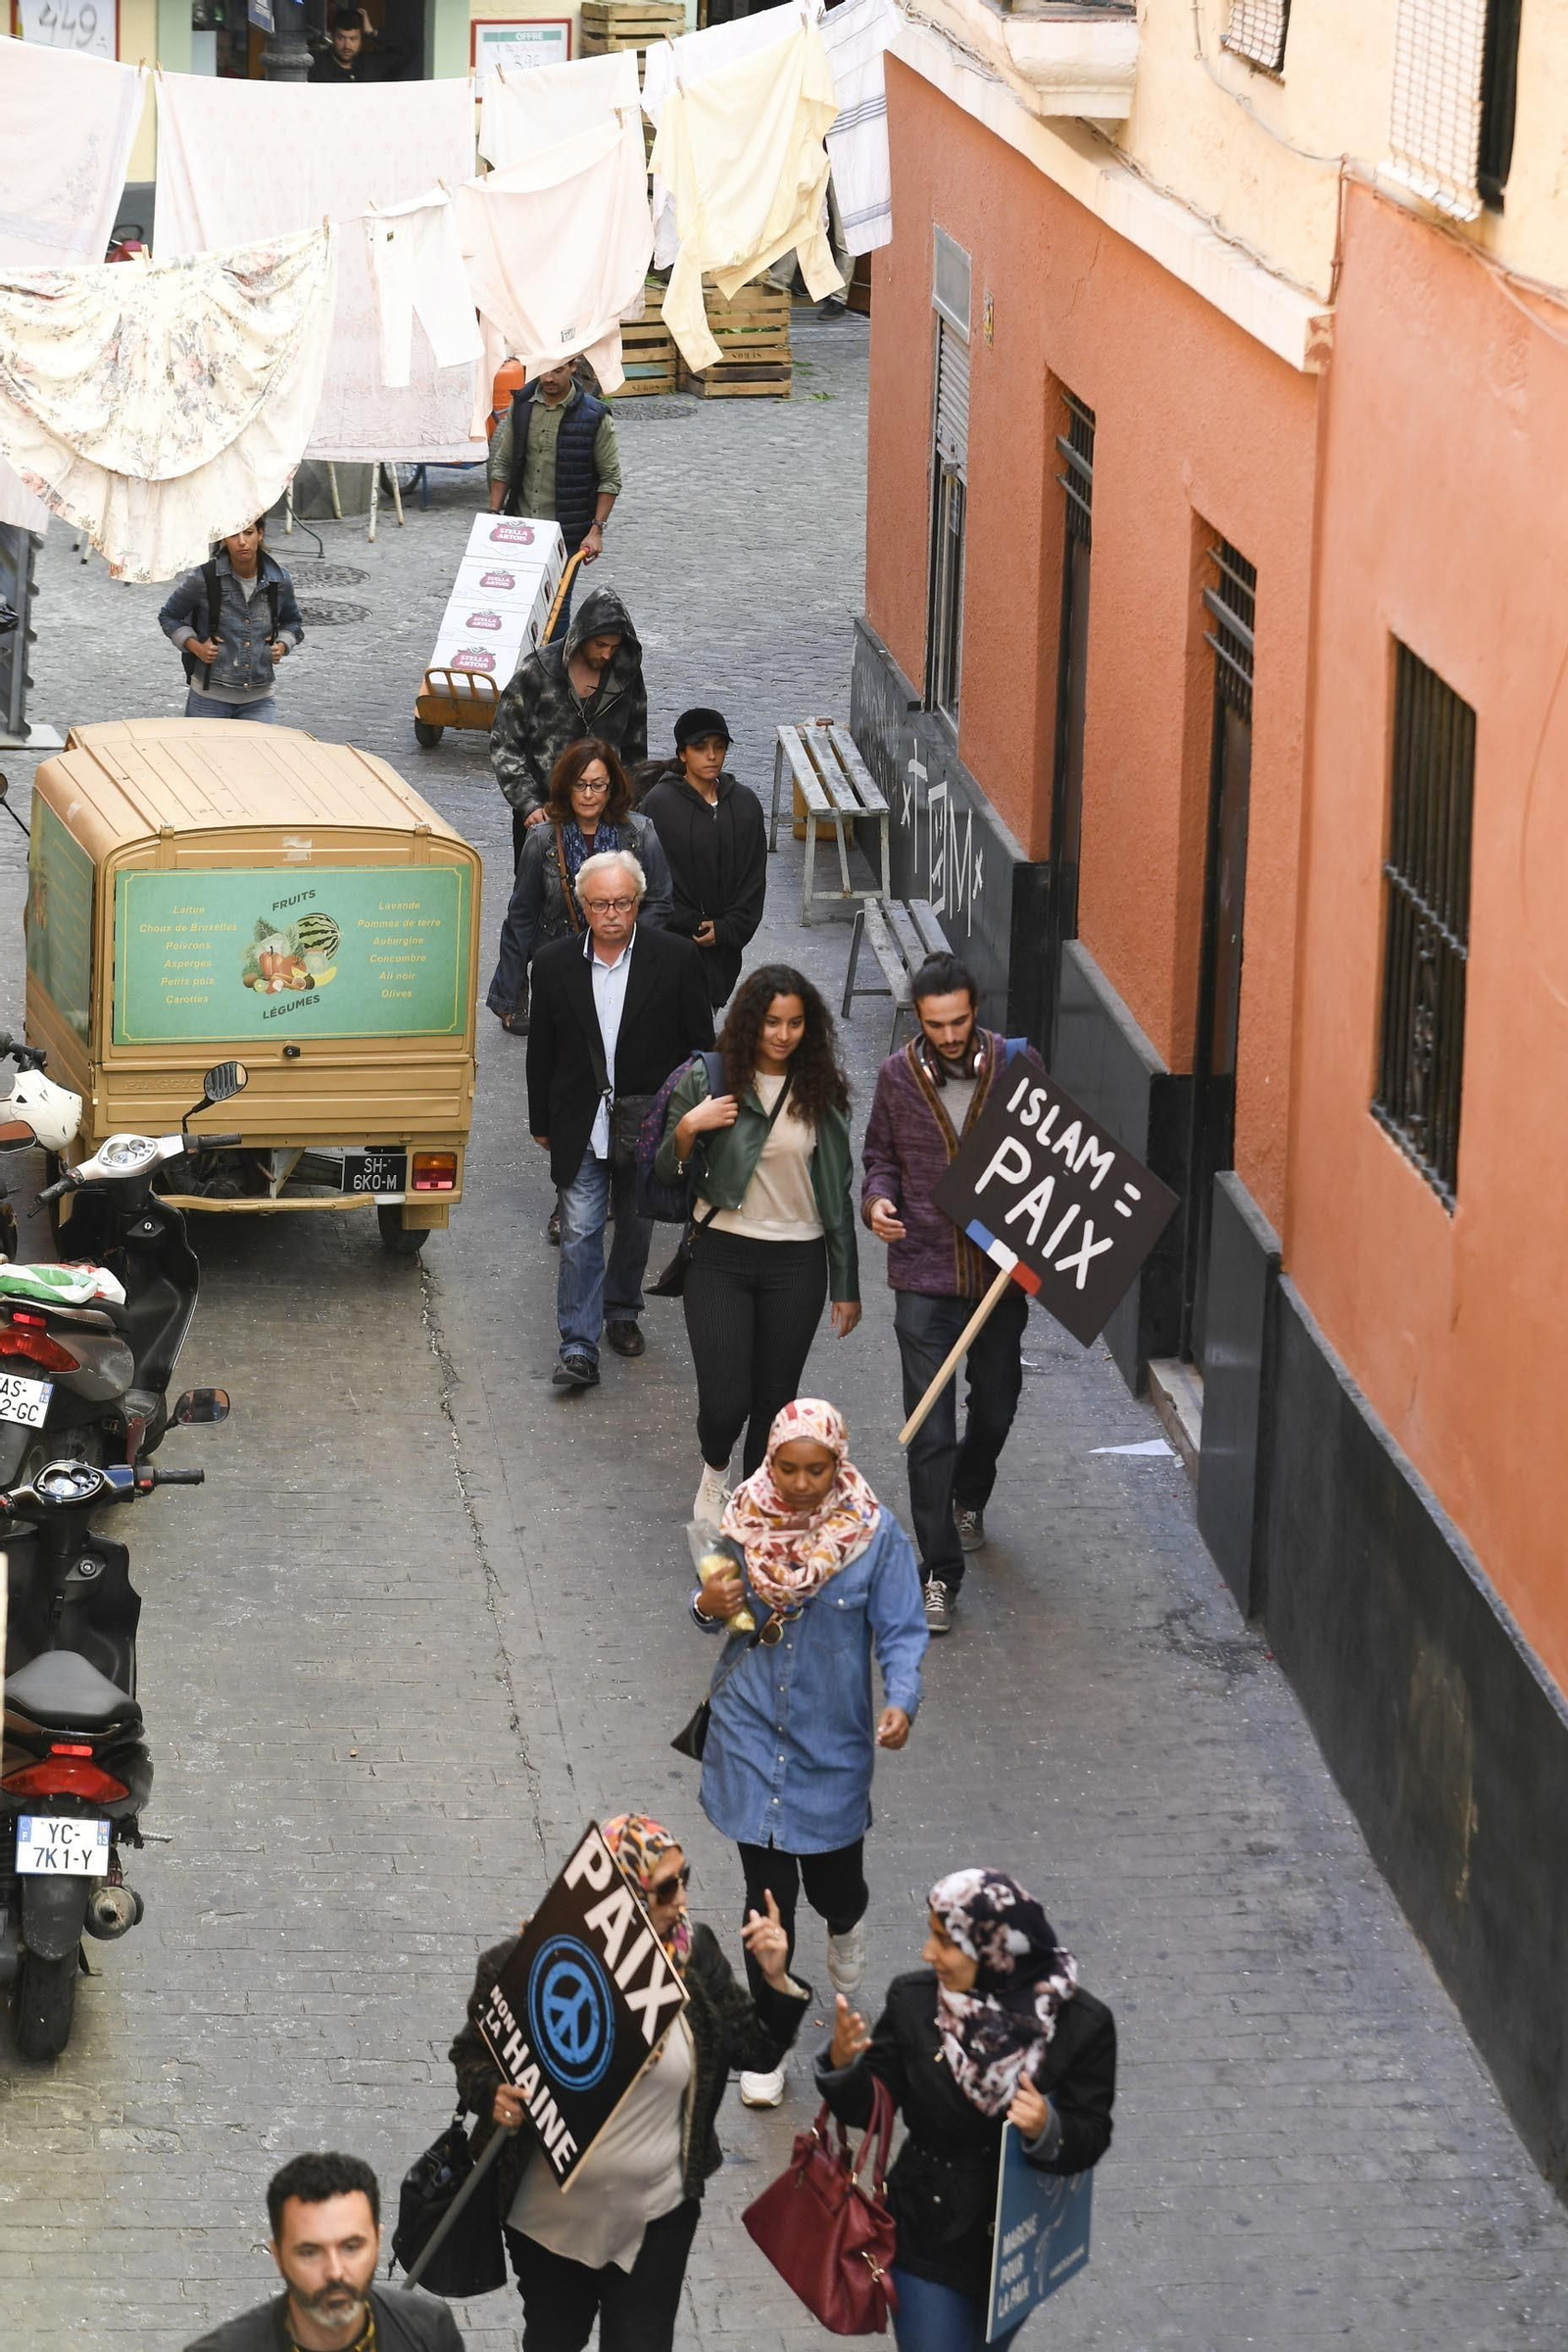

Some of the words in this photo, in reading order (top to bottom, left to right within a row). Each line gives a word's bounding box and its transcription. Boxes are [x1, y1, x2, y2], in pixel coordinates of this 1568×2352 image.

[515, 31, 544, 41] OFFRE
[499, 527, 527, 537] STELLA
[497, 533, 527, 542] ARTOIS
[471, 620, 496, 629] ARTOIS
[459, 654, 489, 663] STELLA
[457, 660, 488, 669] ARTOIS
[271, 889, 317, 911] FRUITS
[172, 905, 205, 914] Laitue
[378, 901, 420, 910] Lavande
[139, 923, 172, 933] Choux
[174, 923, 188, 932] de
[190, 922, 237, 932] Bruxelles
[357, 919, 399, 928] Pommes
[403, 918, 415, 927] de
[417, 918, 441, 927] terre
[165, 941, 211, 951] Poivrons
[372, 936, 424, 947] Aubergine
[369, 954, 426, 963] Concombre
[163, 959, 212, 969] Asperges
[379, 971, 393, 980] Ail
[160, 977, 190, 986] Petits
[192, 977, 215, 987] pois
[380, 989, 413, 999] Olives
[166, 995, 210, 1004] Carottes
[263, 994, 320, 1019] LÉGUMES
[122, 1078, 202, 1090] PIAGGIO
[1005, 1077, 1116, 1192] ISLAM
[974, 1135, 1114, 1291] PAIX
[22, 1832, 28, 1841] F
[98, 1836, 108, 1845] 13
[33, 1846, 92, 1871] 7K1-Y
[563, 1828, 684, 2047] PAIX
[490, 1984, 516, 2034] NON
[485, 2007, 502, 2039] LA
[502, 2027, 578, 2175] HAINE
